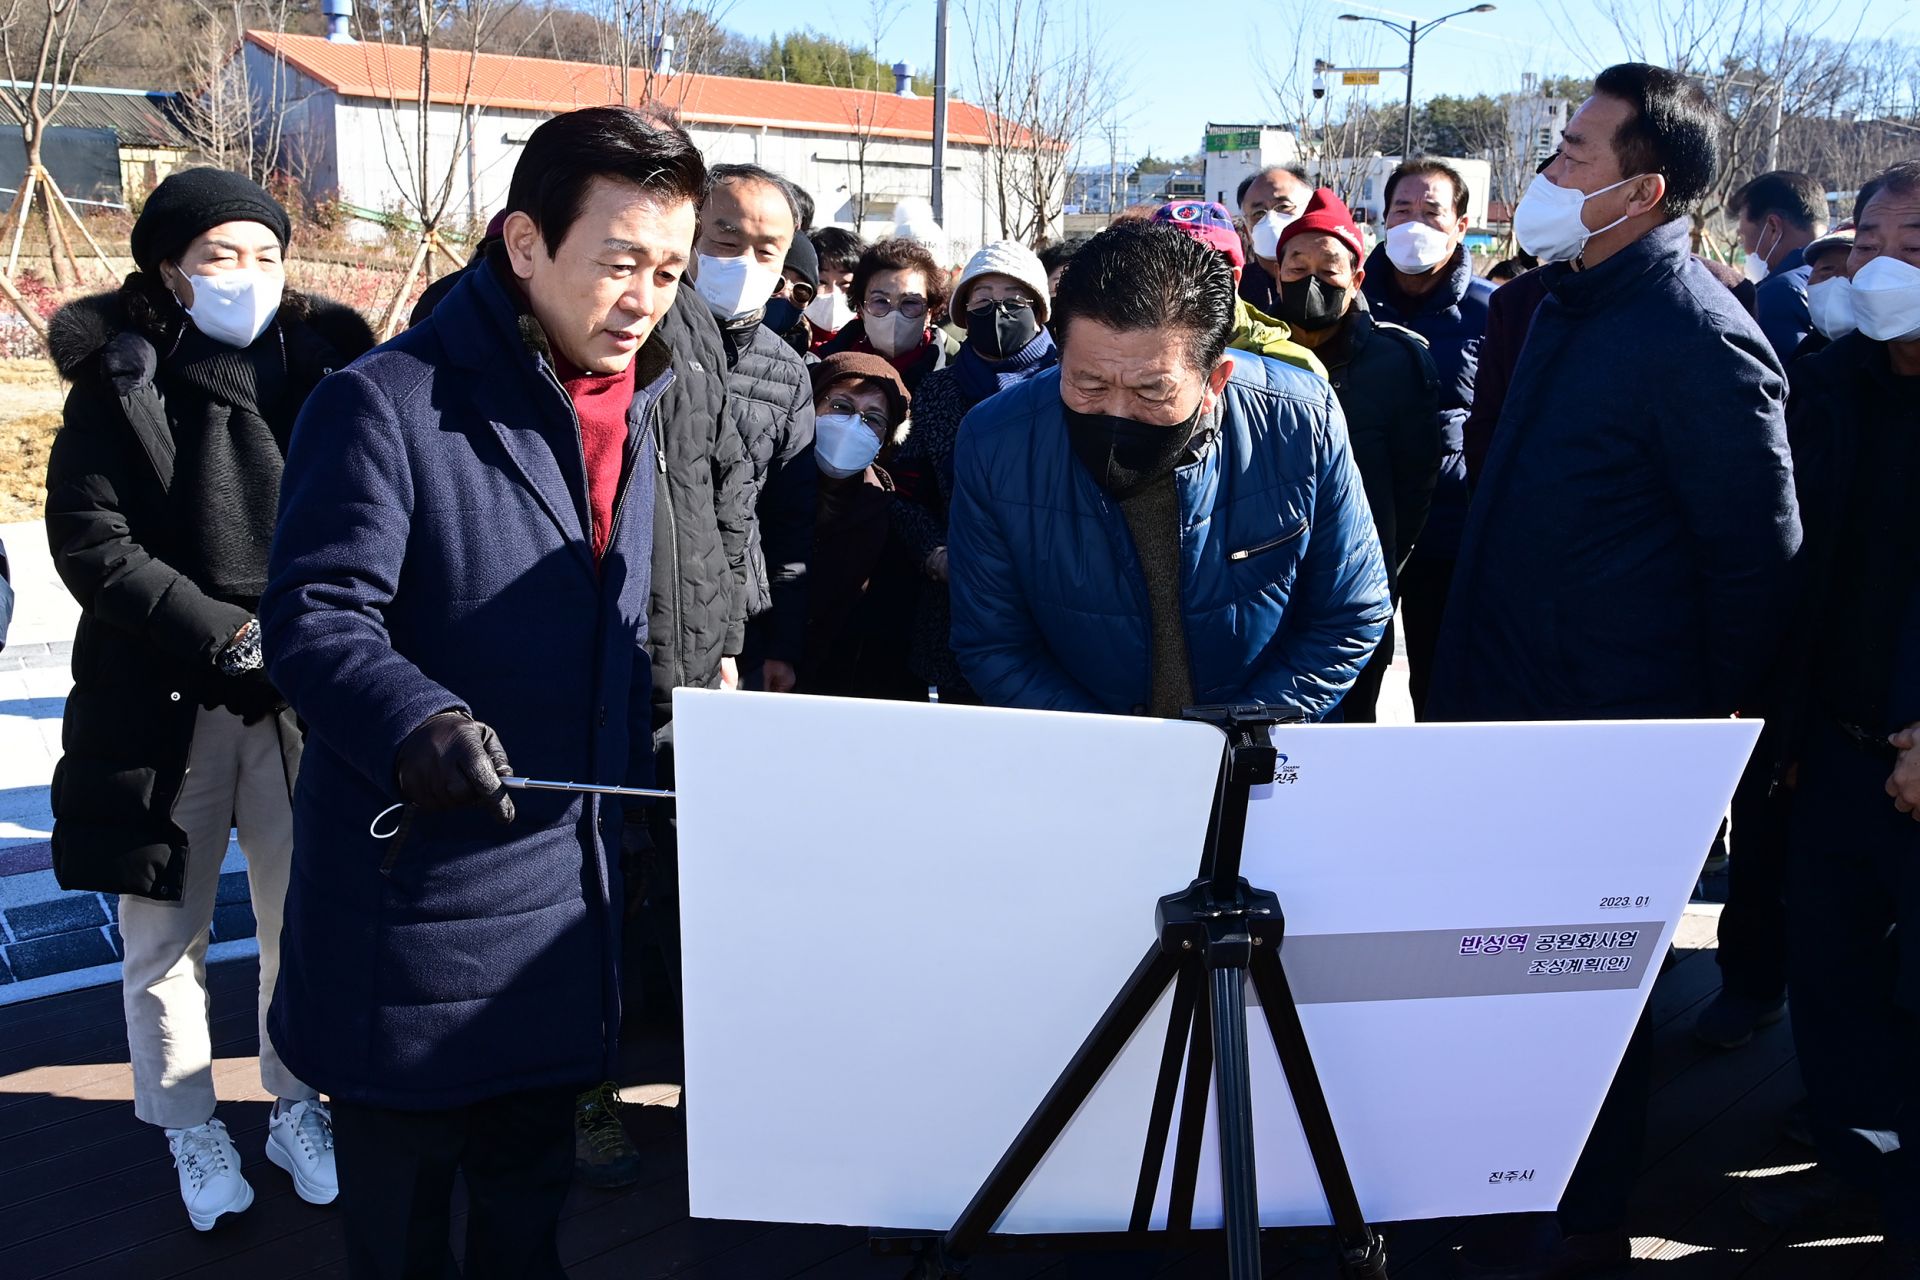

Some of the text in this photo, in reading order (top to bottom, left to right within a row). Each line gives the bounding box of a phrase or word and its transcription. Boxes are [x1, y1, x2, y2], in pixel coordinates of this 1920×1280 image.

[1274, 771, 1298, 784] 진주
[1600, 896, 1650, 908] 2023. 01
[1460, 930, 1638, 954] 반성역 공원화사업
[1488, 1169, 1535, 1183] 진주시
